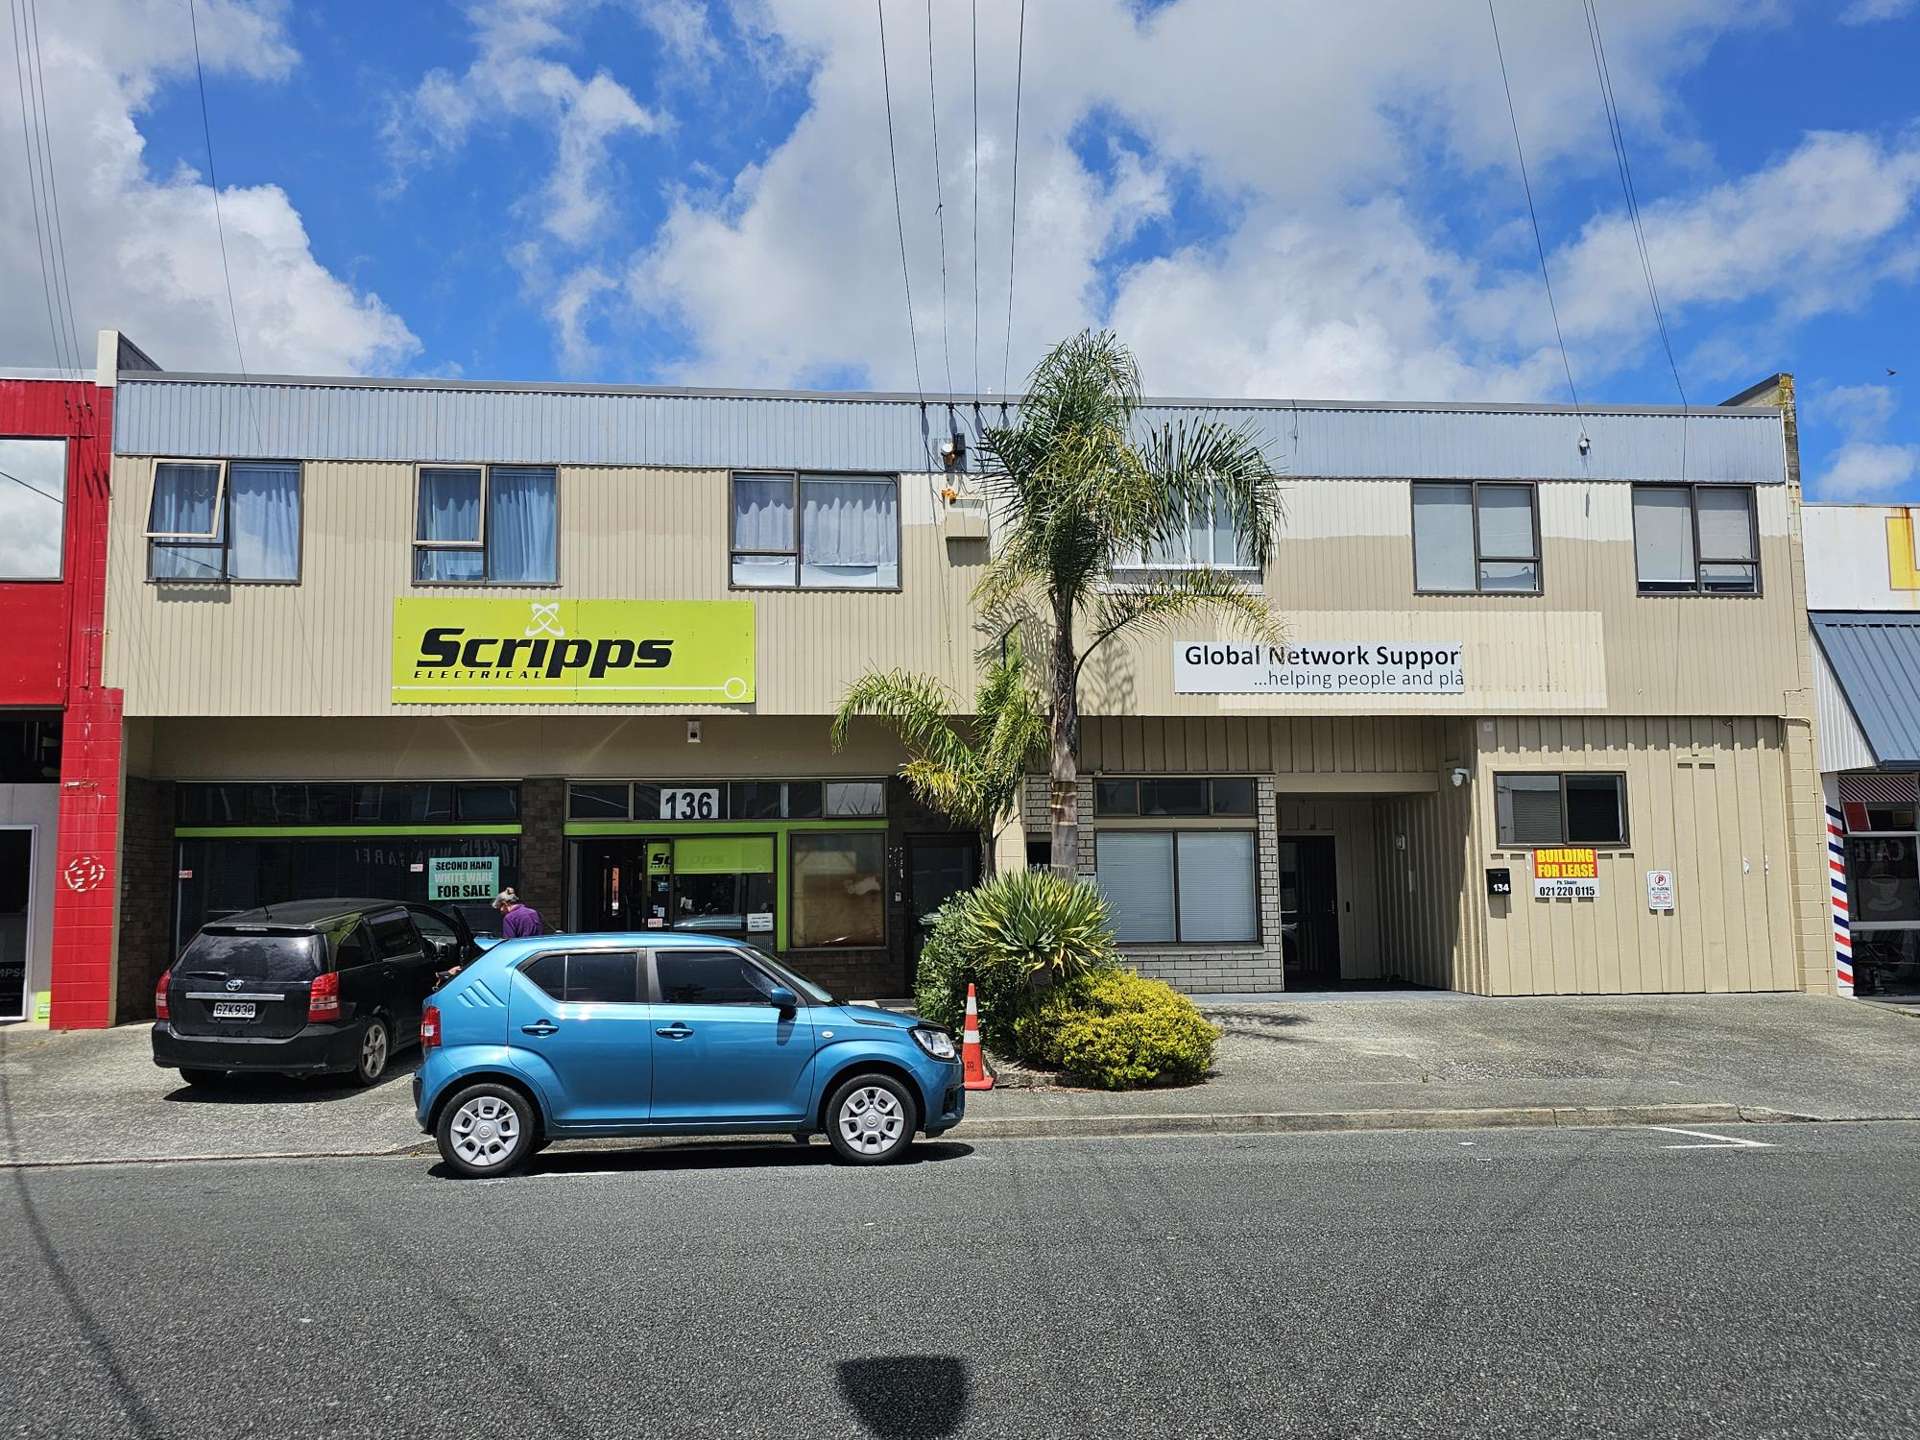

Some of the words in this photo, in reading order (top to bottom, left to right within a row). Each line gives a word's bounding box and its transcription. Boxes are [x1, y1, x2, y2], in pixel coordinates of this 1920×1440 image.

[416, 628, 675, 679] Scripps
[1185, 645, 1261, 665] Global
[1269, 646, 1370, 666] Network
[1377, 646, 1461, 670] Suppor
[414, 670, 542, 679] ELECTRICAL
[1338, 670, 1396, 689] people
[1401, 670, 1433, 685] and
[665, 791, 713, 820] 136
[1537, 849, 1594, 863] BUILDING
[435, 861, 468, 871] SECOND
[470, 861, 492, 870] HAND
[1538, 864, 1559, 877] FOR
[1562, 864, 1595, 877] LEASE
[437, 885, 460, 898] FOR
[463, 884, 491, 897] SALE
[1493, 883, 1510, 892] 134
[1539, 886, 1555, 896] 021
[1557, 886, 1573, 896] 220
[1575, 886, 1595, 896] 0115
